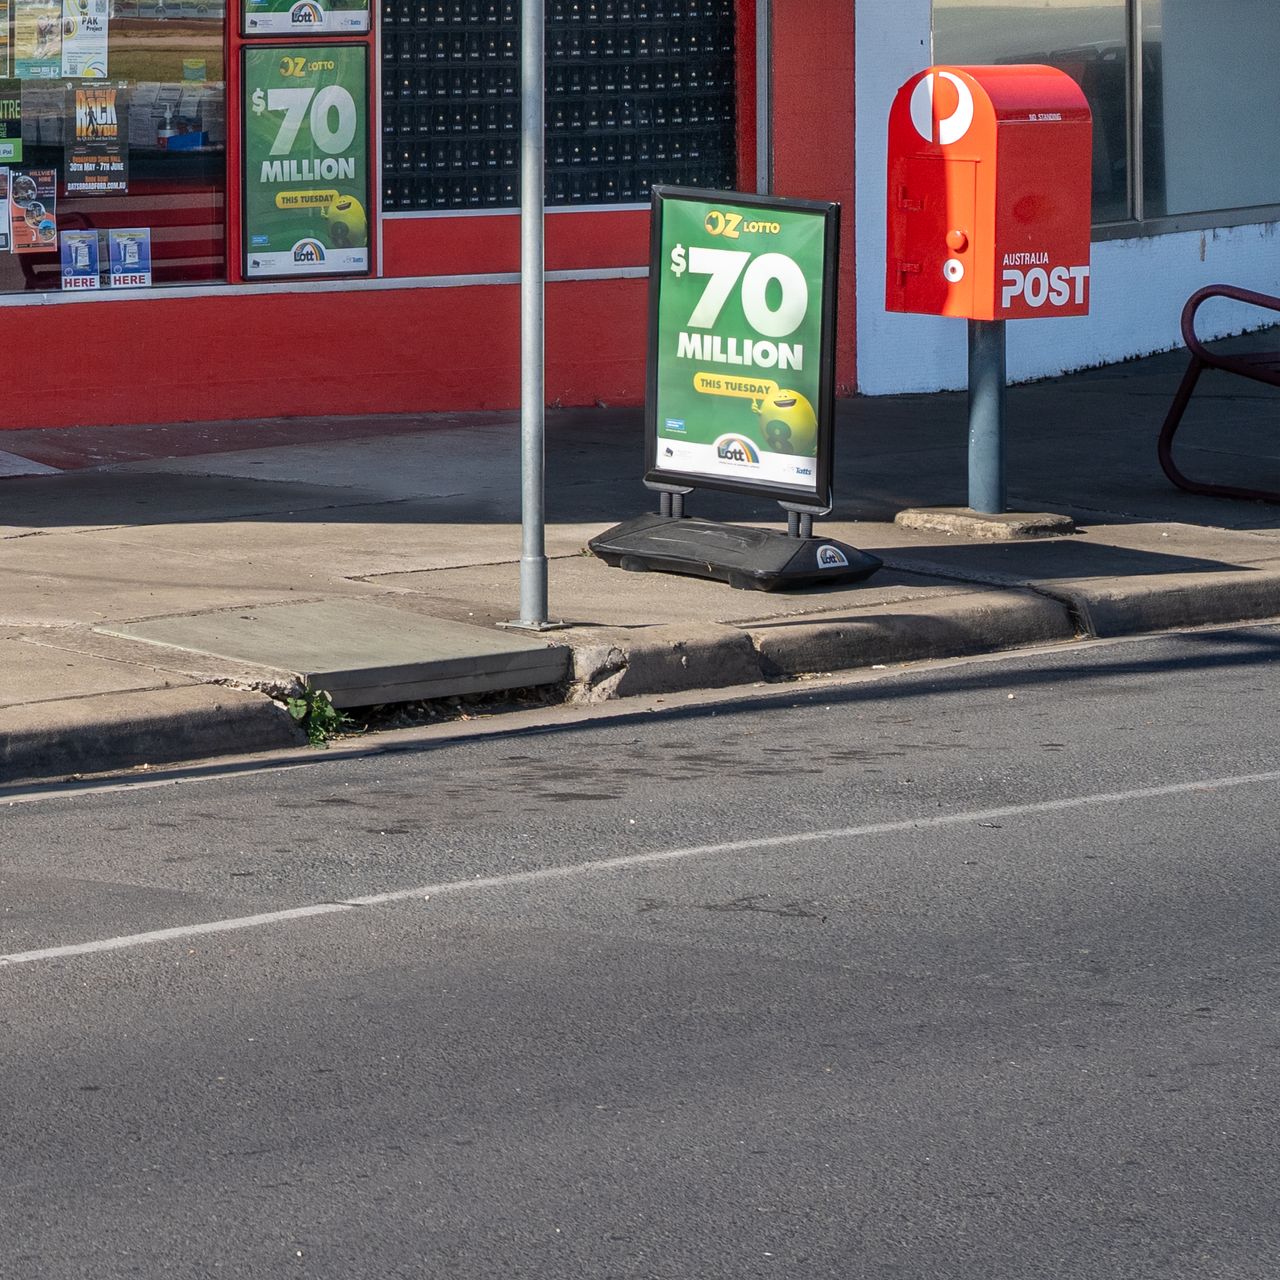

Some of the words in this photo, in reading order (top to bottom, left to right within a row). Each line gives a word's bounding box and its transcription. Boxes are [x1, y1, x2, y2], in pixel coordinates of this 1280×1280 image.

[81, 17, 99, 25] PAK
[280, 56, 306, 77] OZ
[308, 60, 335, 71] LOTTO
[1037, 112, 1062, 121] STANDING
[84, 163, 96, 171] MAY
[100, 163, 110, 171] 7TH
[111, 163, 124, 171] JUNE
[260, 157, 356, 183] MILLION
[281, 195, 298, 204] THIS
[300, 194, 334, 204] TUESDAY
[704, 210, 744, 238] OZ
[743, 221, 780, 234] LOTTO
[1002, 252, 1049, 266] AUSTRALIA
[64, 277, 96, 288] HERE
[112, 275, 146, 286] HERE
[1001, 266, 1090, 308] POST
[676, 331, 803, 371] MILLION
[700, 378, 722, 389] THIS
[724, 381, 771, 395] TUESDAY
[717, 445, 745, 462] Lott
